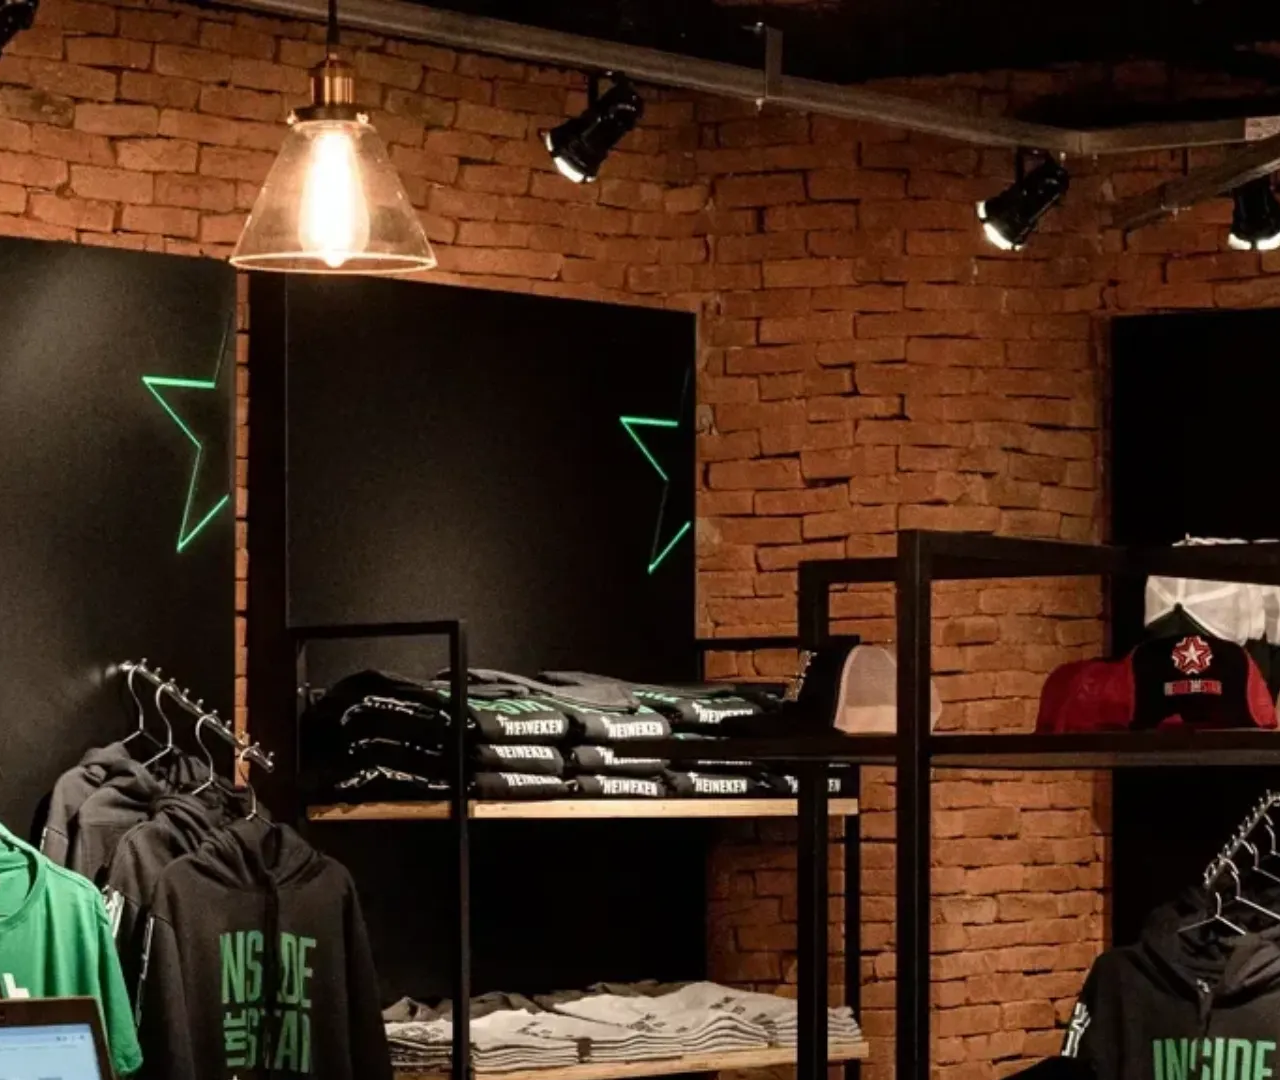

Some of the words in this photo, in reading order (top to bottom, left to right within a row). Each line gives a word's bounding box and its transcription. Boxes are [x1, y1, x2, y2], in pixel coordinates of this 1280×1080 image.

[504, 719, 563, 736] HEINEKEN
[607, 721, 663, 738] HEINEKEN
[603, 779, 658, 796] HEINEKEN
[694, 778, 748, 794] HEINEKEN
[220, 930, 317, 1008] NSDE
